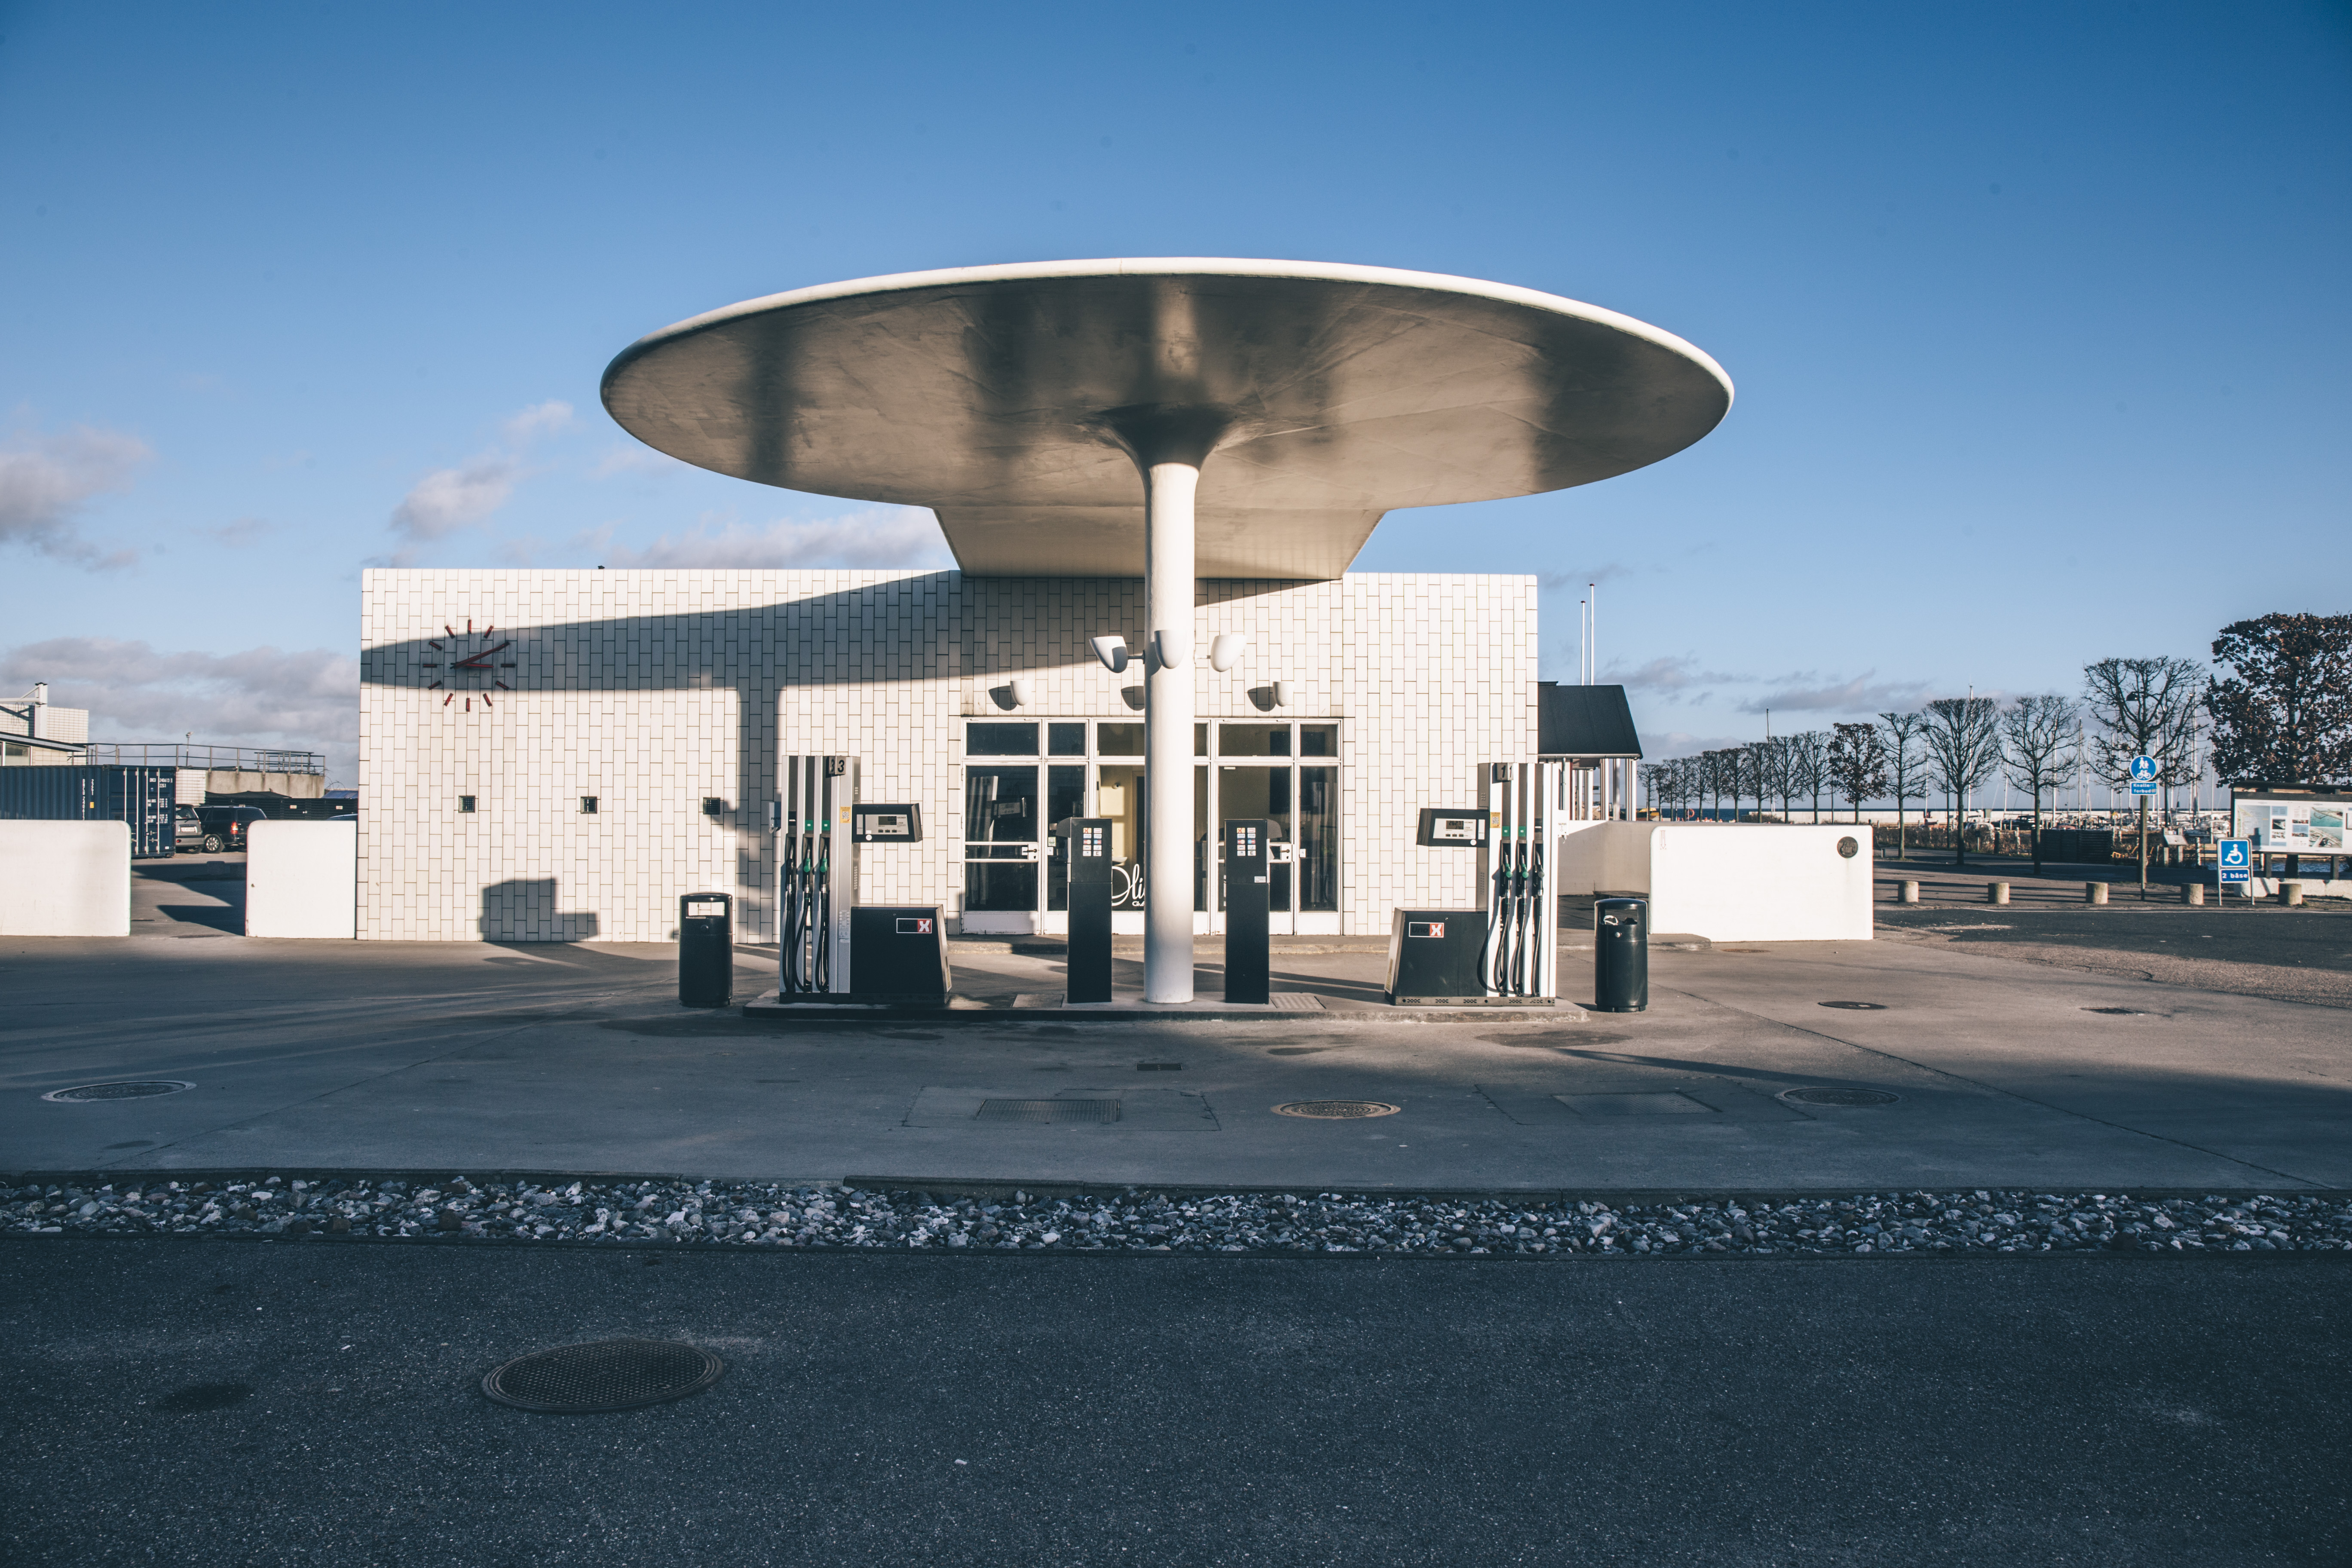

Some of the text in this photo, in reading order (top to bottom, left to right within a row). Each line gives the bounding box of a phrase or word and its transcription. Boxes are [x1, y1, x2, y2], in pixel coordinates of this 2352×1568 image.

[838, 760, 845, 772] 3
[1501, 766, 1506, 778] 1
[1510, 766, 1512, 778] 1
